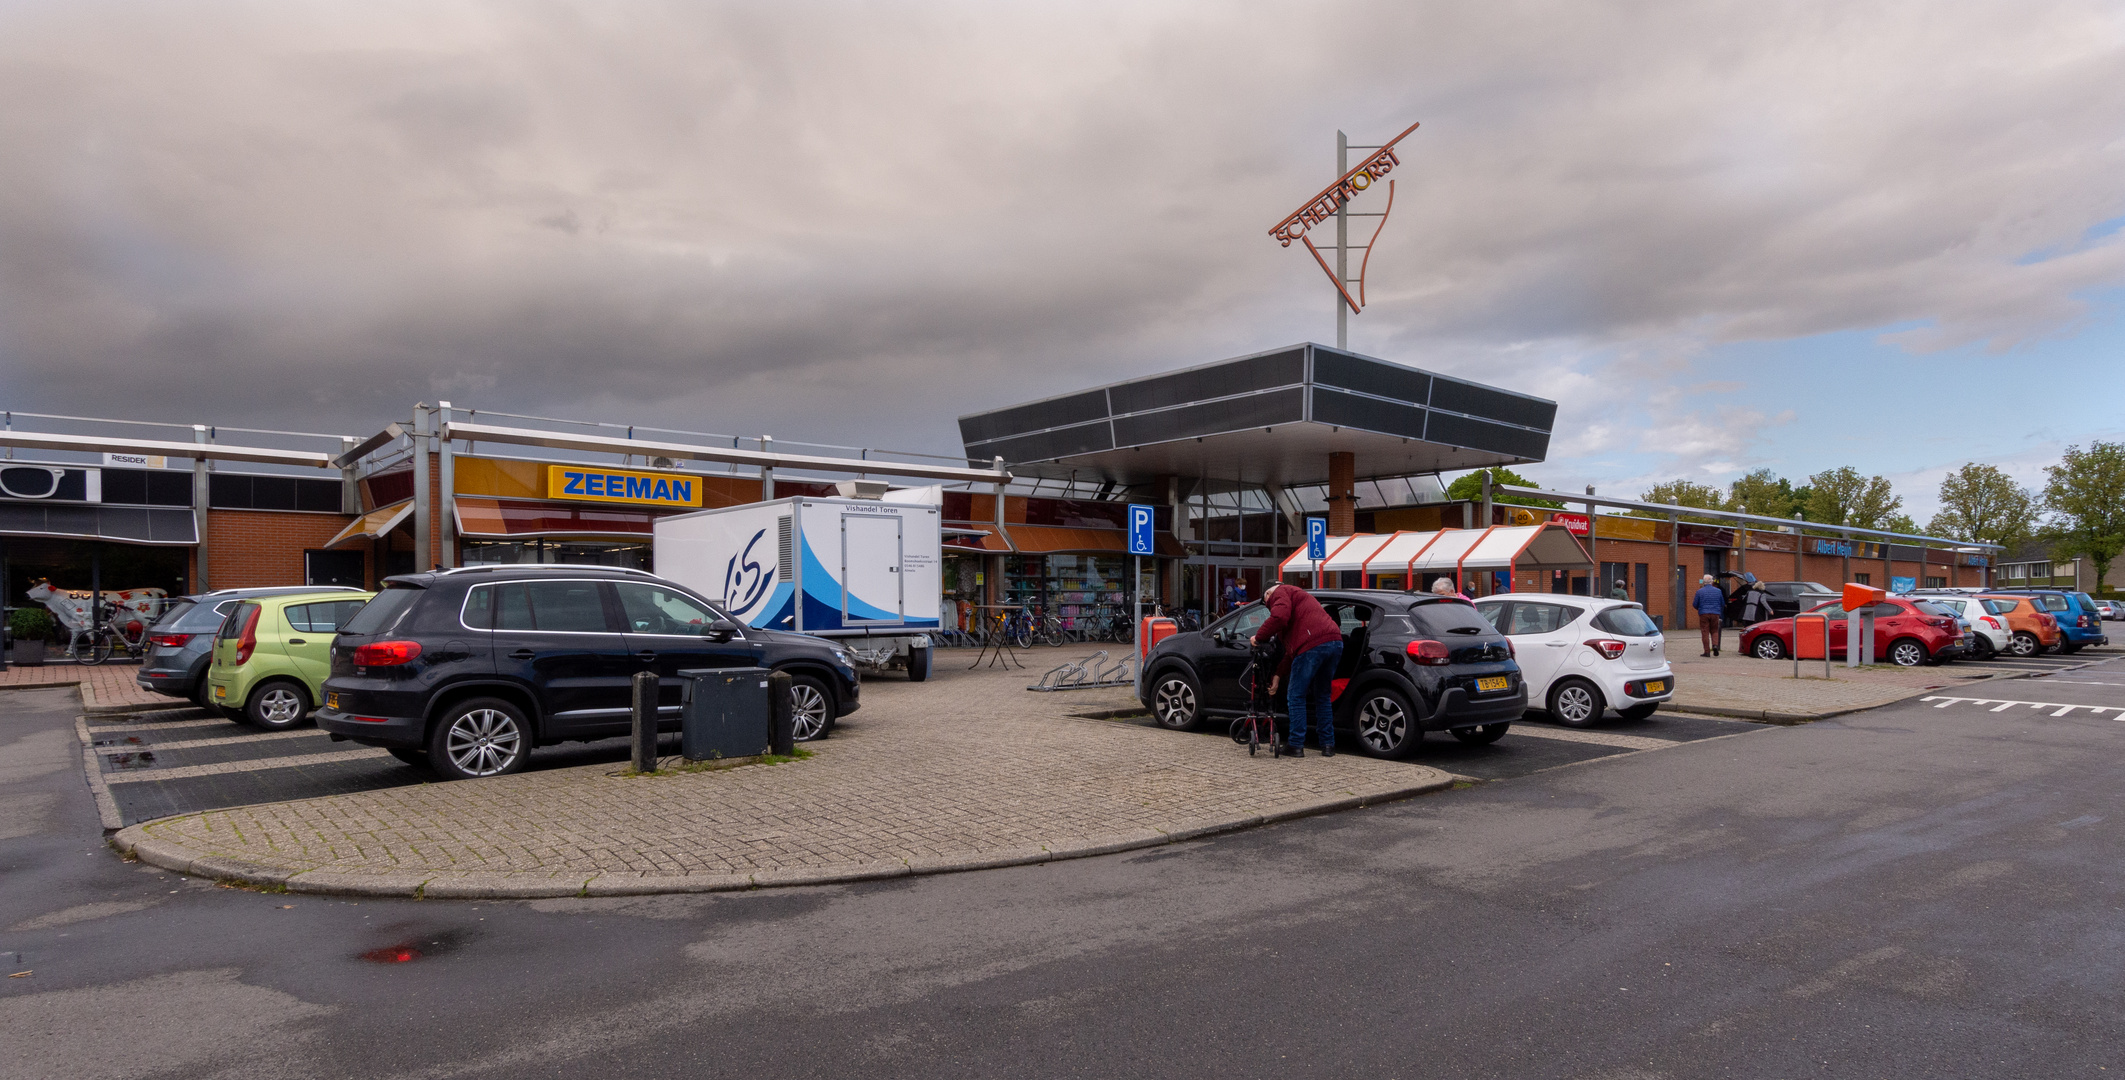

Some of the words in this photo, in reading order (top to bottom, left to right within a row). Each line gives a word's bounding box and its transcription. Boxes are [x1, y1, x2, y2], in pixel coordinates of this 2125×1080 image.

[1275, 148, 1401, 248] SCHELFHORST
[111, 454, 146, 465] RESIDEK
[563, 471, 692, 502] ZEEMAN
[845, 505, 878, 513] Vishandel
[880, 506, 898, 514] Toren
[1135, 510, 1149, 534] P
[1312, 521, 1323, 543] P
[1564, 518, 1588, 531] Kruidvat
[1816, 539, 1836, 555] Albert
[1836, 541, 1852, 559] Heijn
